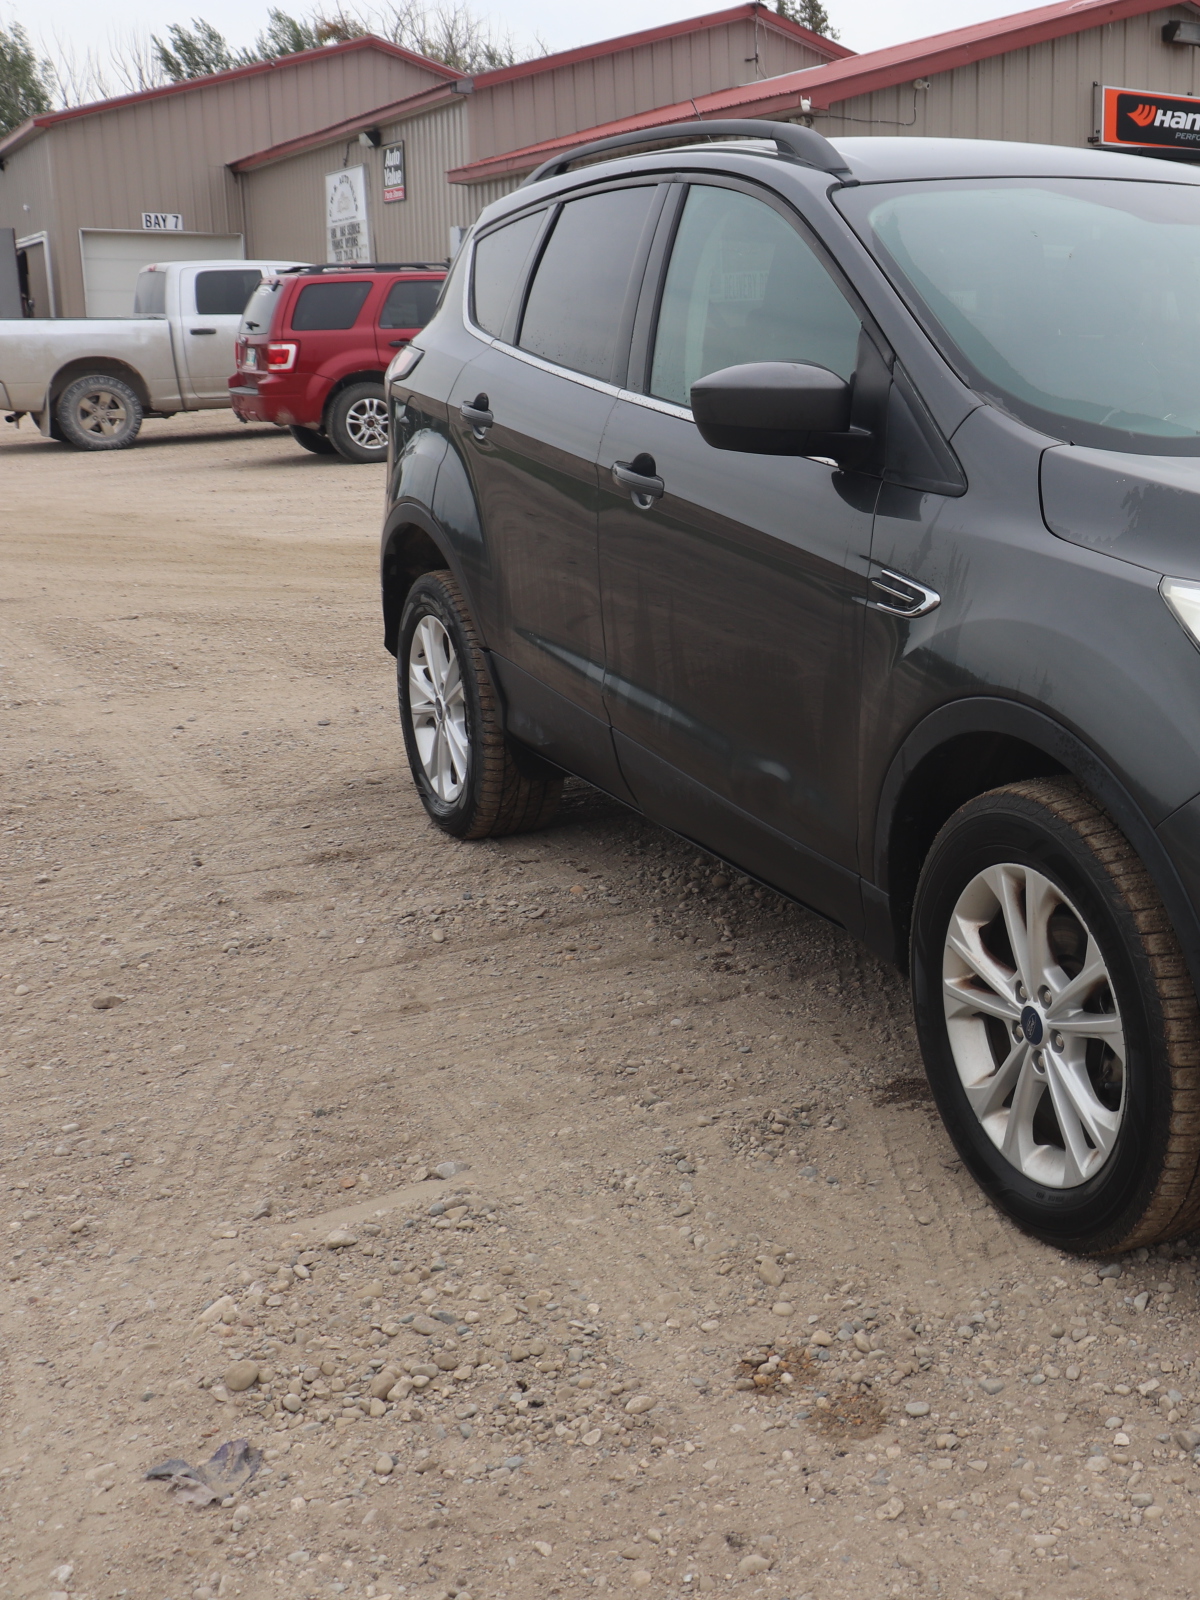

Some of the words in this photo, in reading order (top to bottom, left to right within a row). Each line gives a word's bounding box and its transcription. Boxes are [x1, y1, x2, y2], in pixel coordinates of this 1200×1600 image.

[385, 147, 400, 167] Auto
[384, 167, 402, 186] Value
[144, 214, 168, 229] BAY
[172, 215, 179, 229] 7
